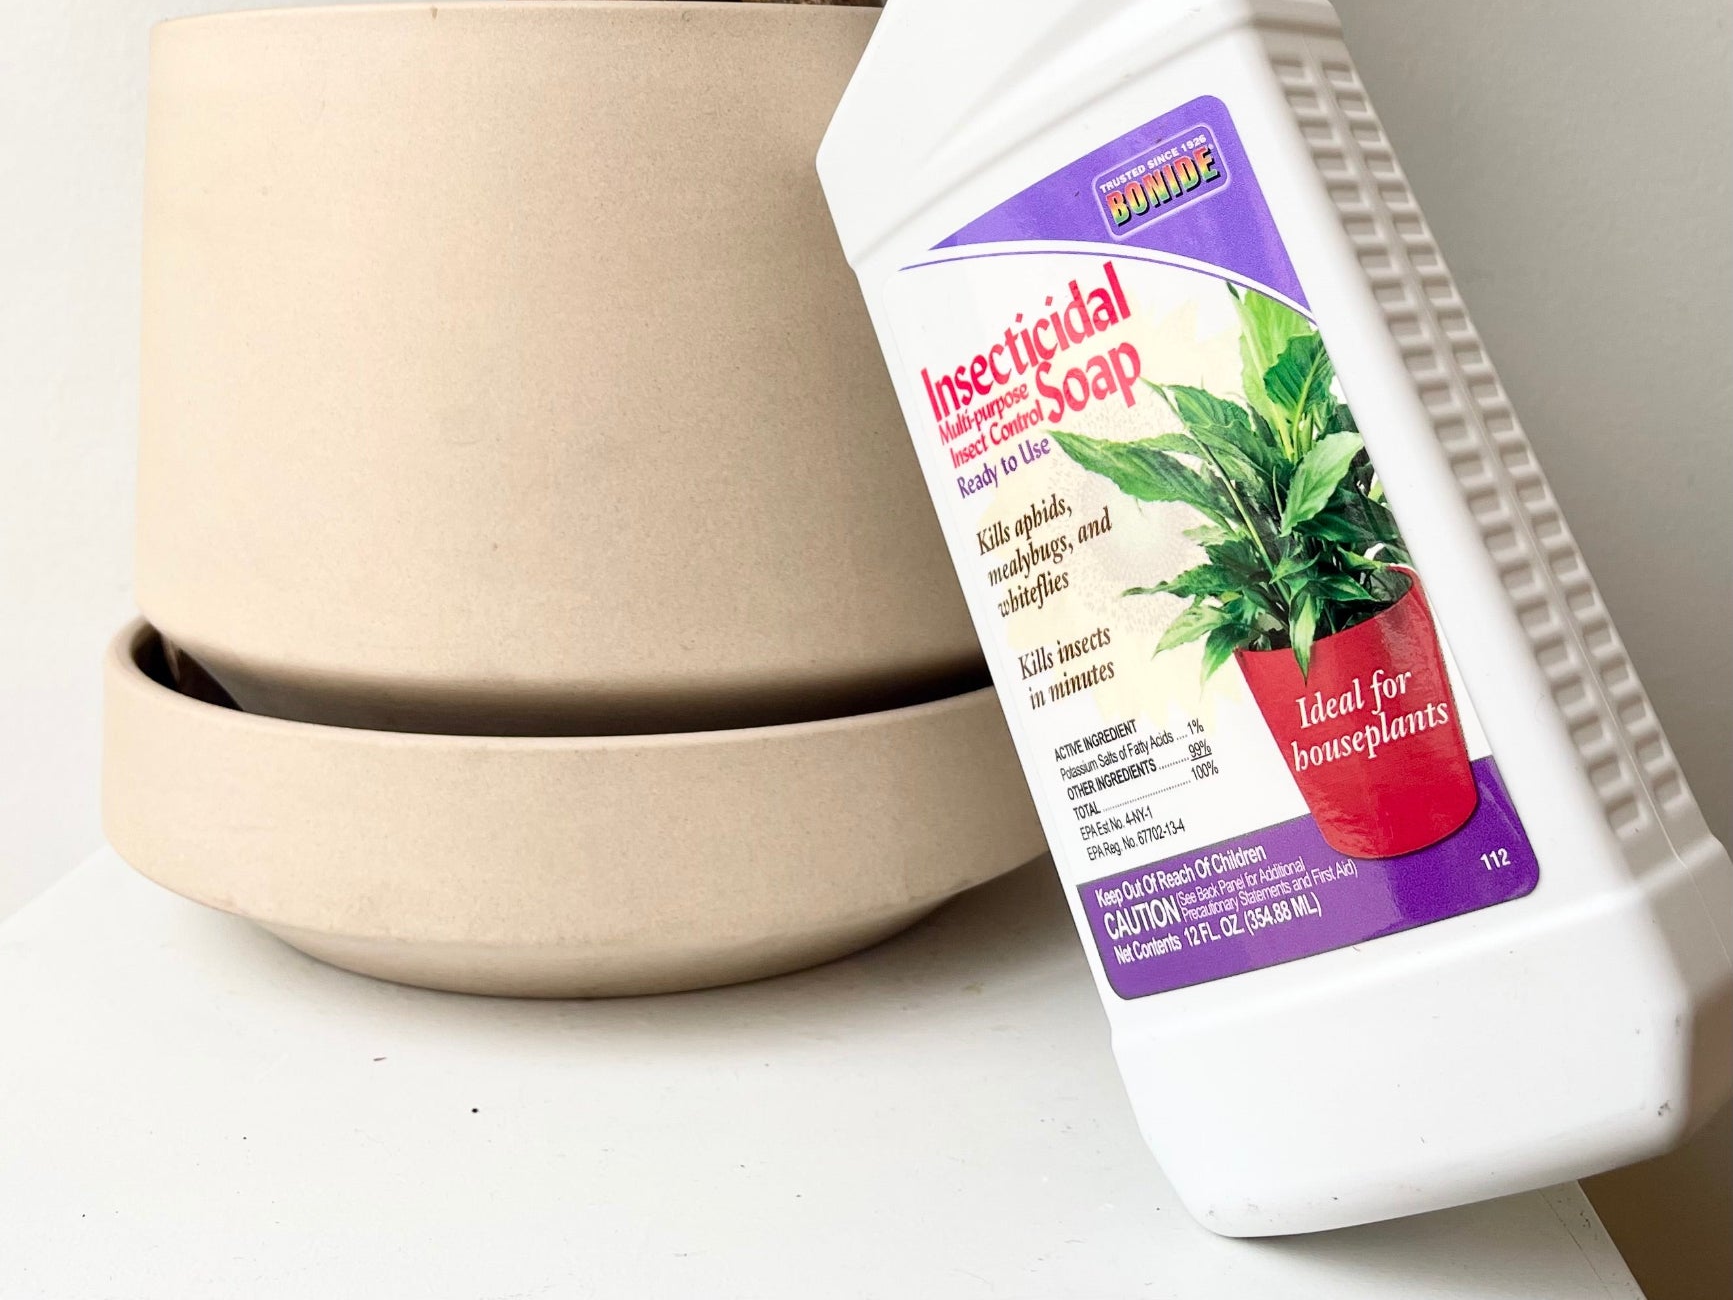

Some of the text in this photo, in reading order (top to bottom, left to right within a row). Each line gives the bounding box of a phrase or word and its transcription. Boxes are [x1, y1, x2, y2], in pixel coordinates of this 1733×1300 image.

[1100, 134, 1206, 193] TRUSTED SINCE 1926
[920, 260, 1131, 422] Insecticidal
[1035, 342, 1141, 423] Soap
[938, 383, 1029, 445] Multi-purpose
[949, 399, 1044, 469] Insect Control
[957, 438, 1051, 499] Ready to Use
[975, 493, 1073, 556] Kills aphids,
[987, 505, 1113, 587] mealybugs, and
[997, 571, 1070, 618] whiteflies
[1018, 627, 1111, 681] Kills insects
[1028, 661, 1115, 710] in minutes
[1296, 669, 1411, 729] Ideal for
[1054, 719, 1138, 762] ACTIVE INGREDIENT
[1060, 718, 1204, 781] Potassium Salts of Fatty Acids 1%
[1291, 702, 1449, 772] houseplants
[1067, 738, 1212, 801] OTHER INGREDIENTS 99%
[1073, 760, 1219, 821] TOTAL 100%
[1080, 825, 1098, 841] EPA
[1109, 818, 1125, 832] No.
[1125, 805, 1153, 825] 4-NY-1
[1087, 818, 1186, 861] EPA Reg. No. 67702-13-4
[1095, 845, 1267, 907] Keep Out Of Reach Of Children
[1176, 856, 1306, 908] (See Back Panel for Additional
[1480, 848, 1511, 871] 112
[1103, 895, 1181, 941] CAUTION
[1180, 859, 1358, 922] Precautionary Statements and First Aid)
[1114, 891, 1322, 965] Net Contents 12 FL. OZ. (354.88 ML)
